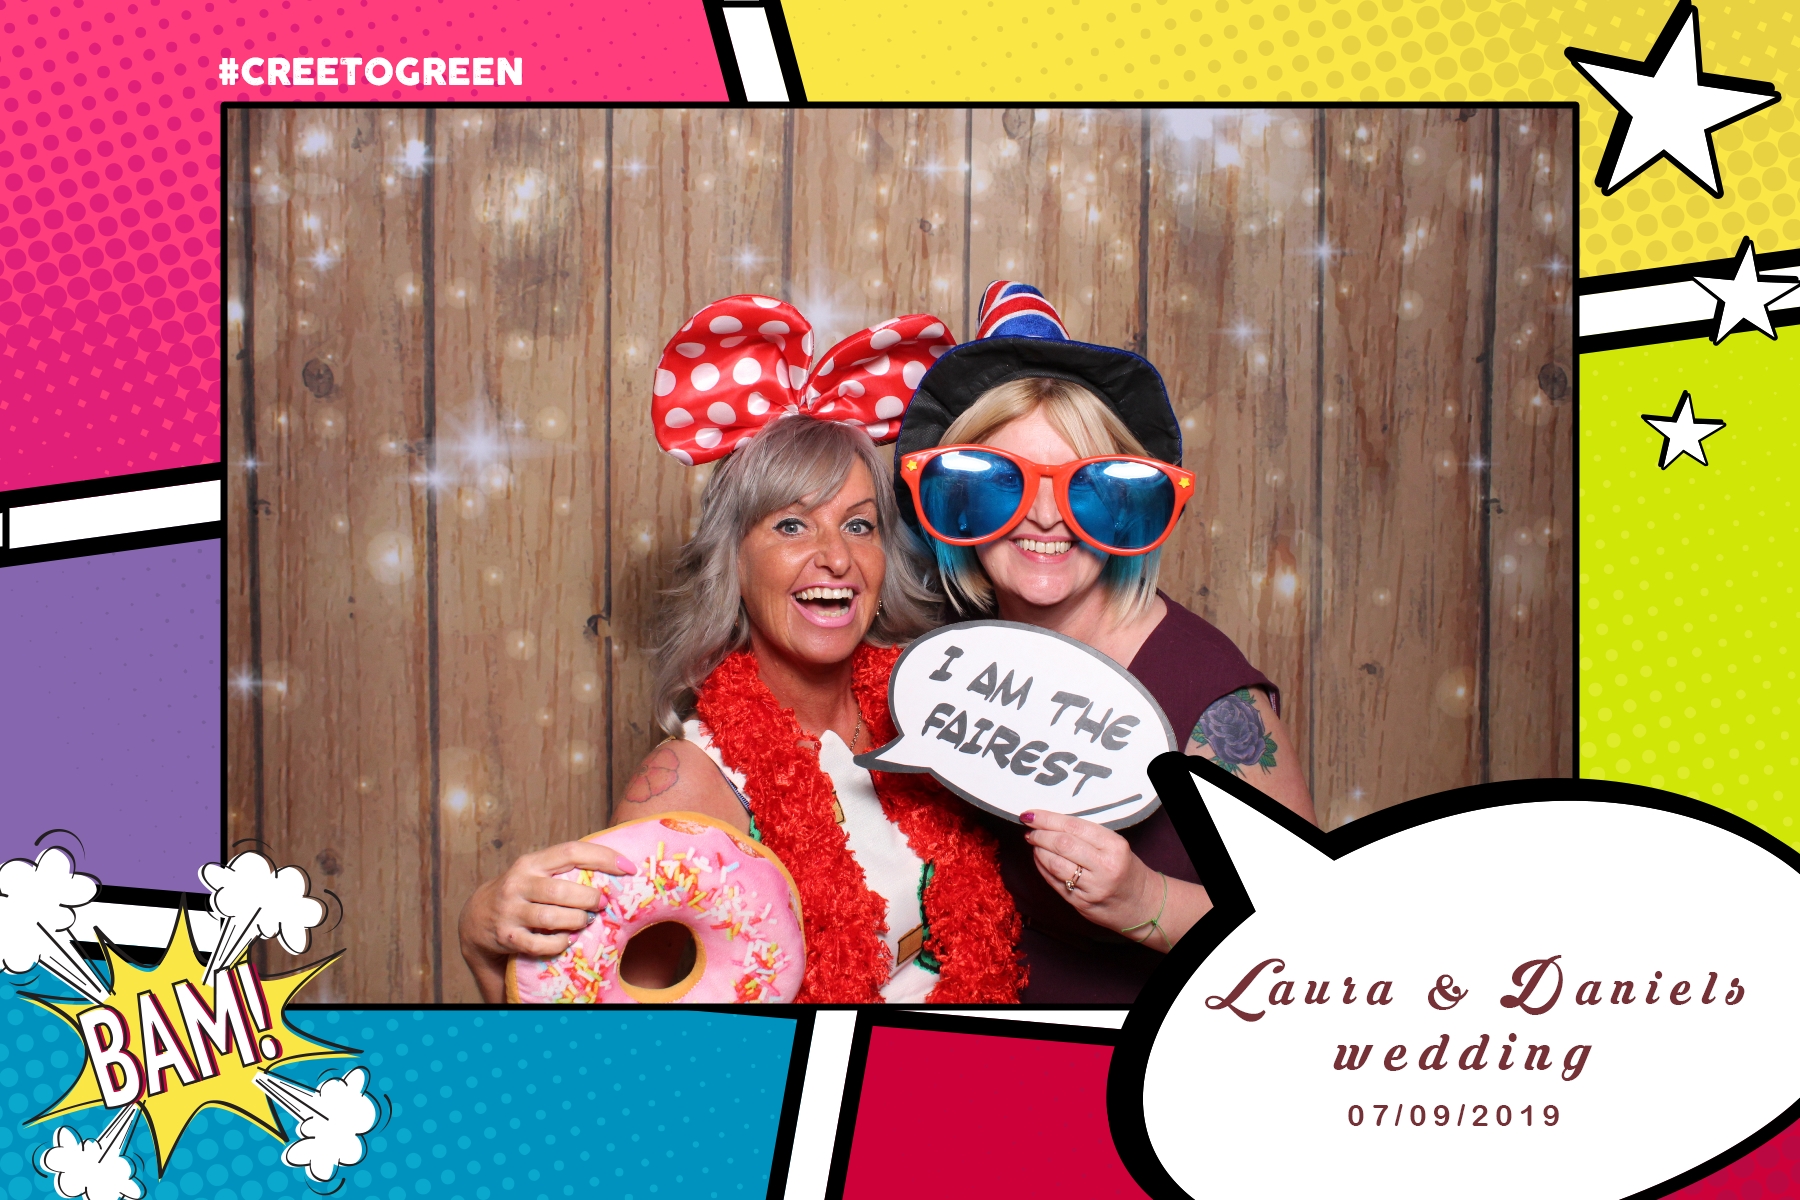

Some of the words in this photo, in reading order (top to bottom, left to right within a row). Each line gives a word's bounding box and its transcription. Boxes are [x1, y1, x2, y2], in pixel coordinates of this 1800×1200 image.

[929, 645, 964, 682] I
[967, 662, 1033, 710] AM
[1051, 691, 1140, 750] THE
[922, 703, 1112, 797] FAIREST
